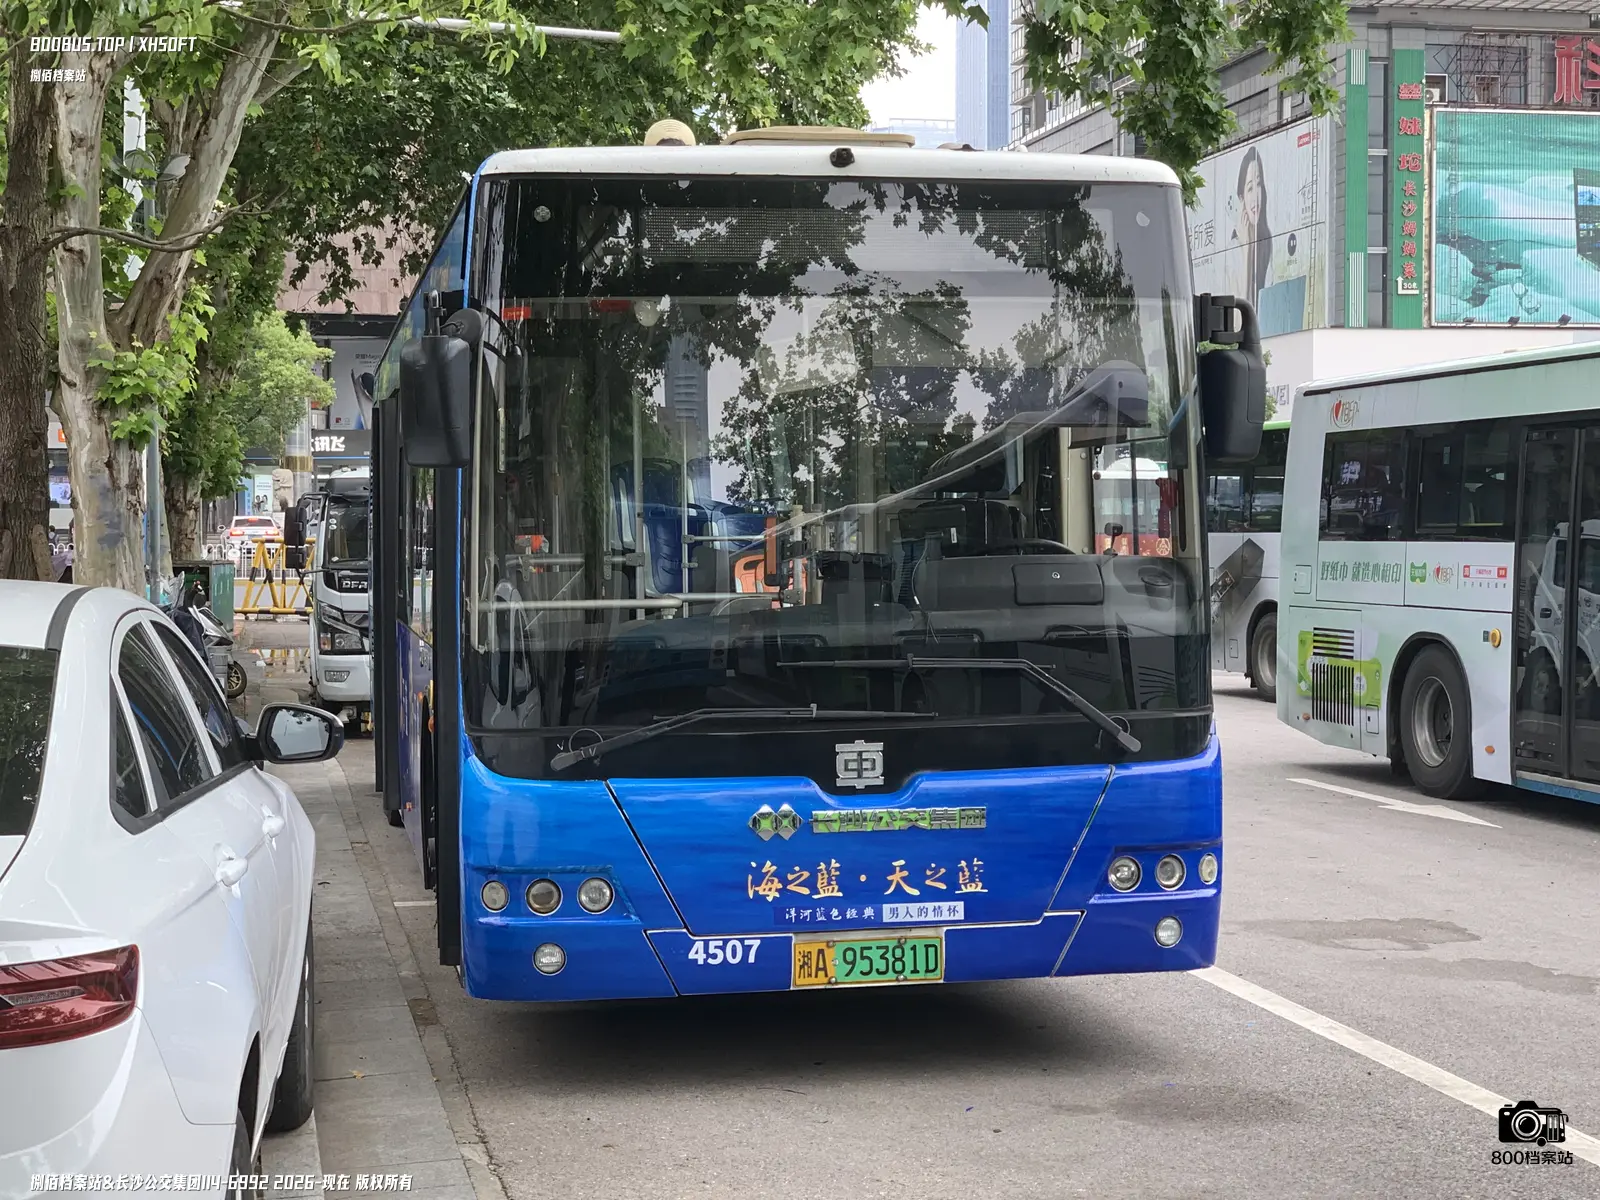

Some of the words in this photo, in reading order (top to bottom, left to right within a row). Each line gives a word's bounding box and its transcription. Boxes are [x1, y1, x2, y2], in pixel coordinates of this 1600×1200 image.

[1402, 180, 1418, 279] 长沙妈妈菜
[310, 436, 346, 452] 讯飞
[1320, 561, 1349, 582] 好纸巾
[688, 939, 761, 965] 4507
